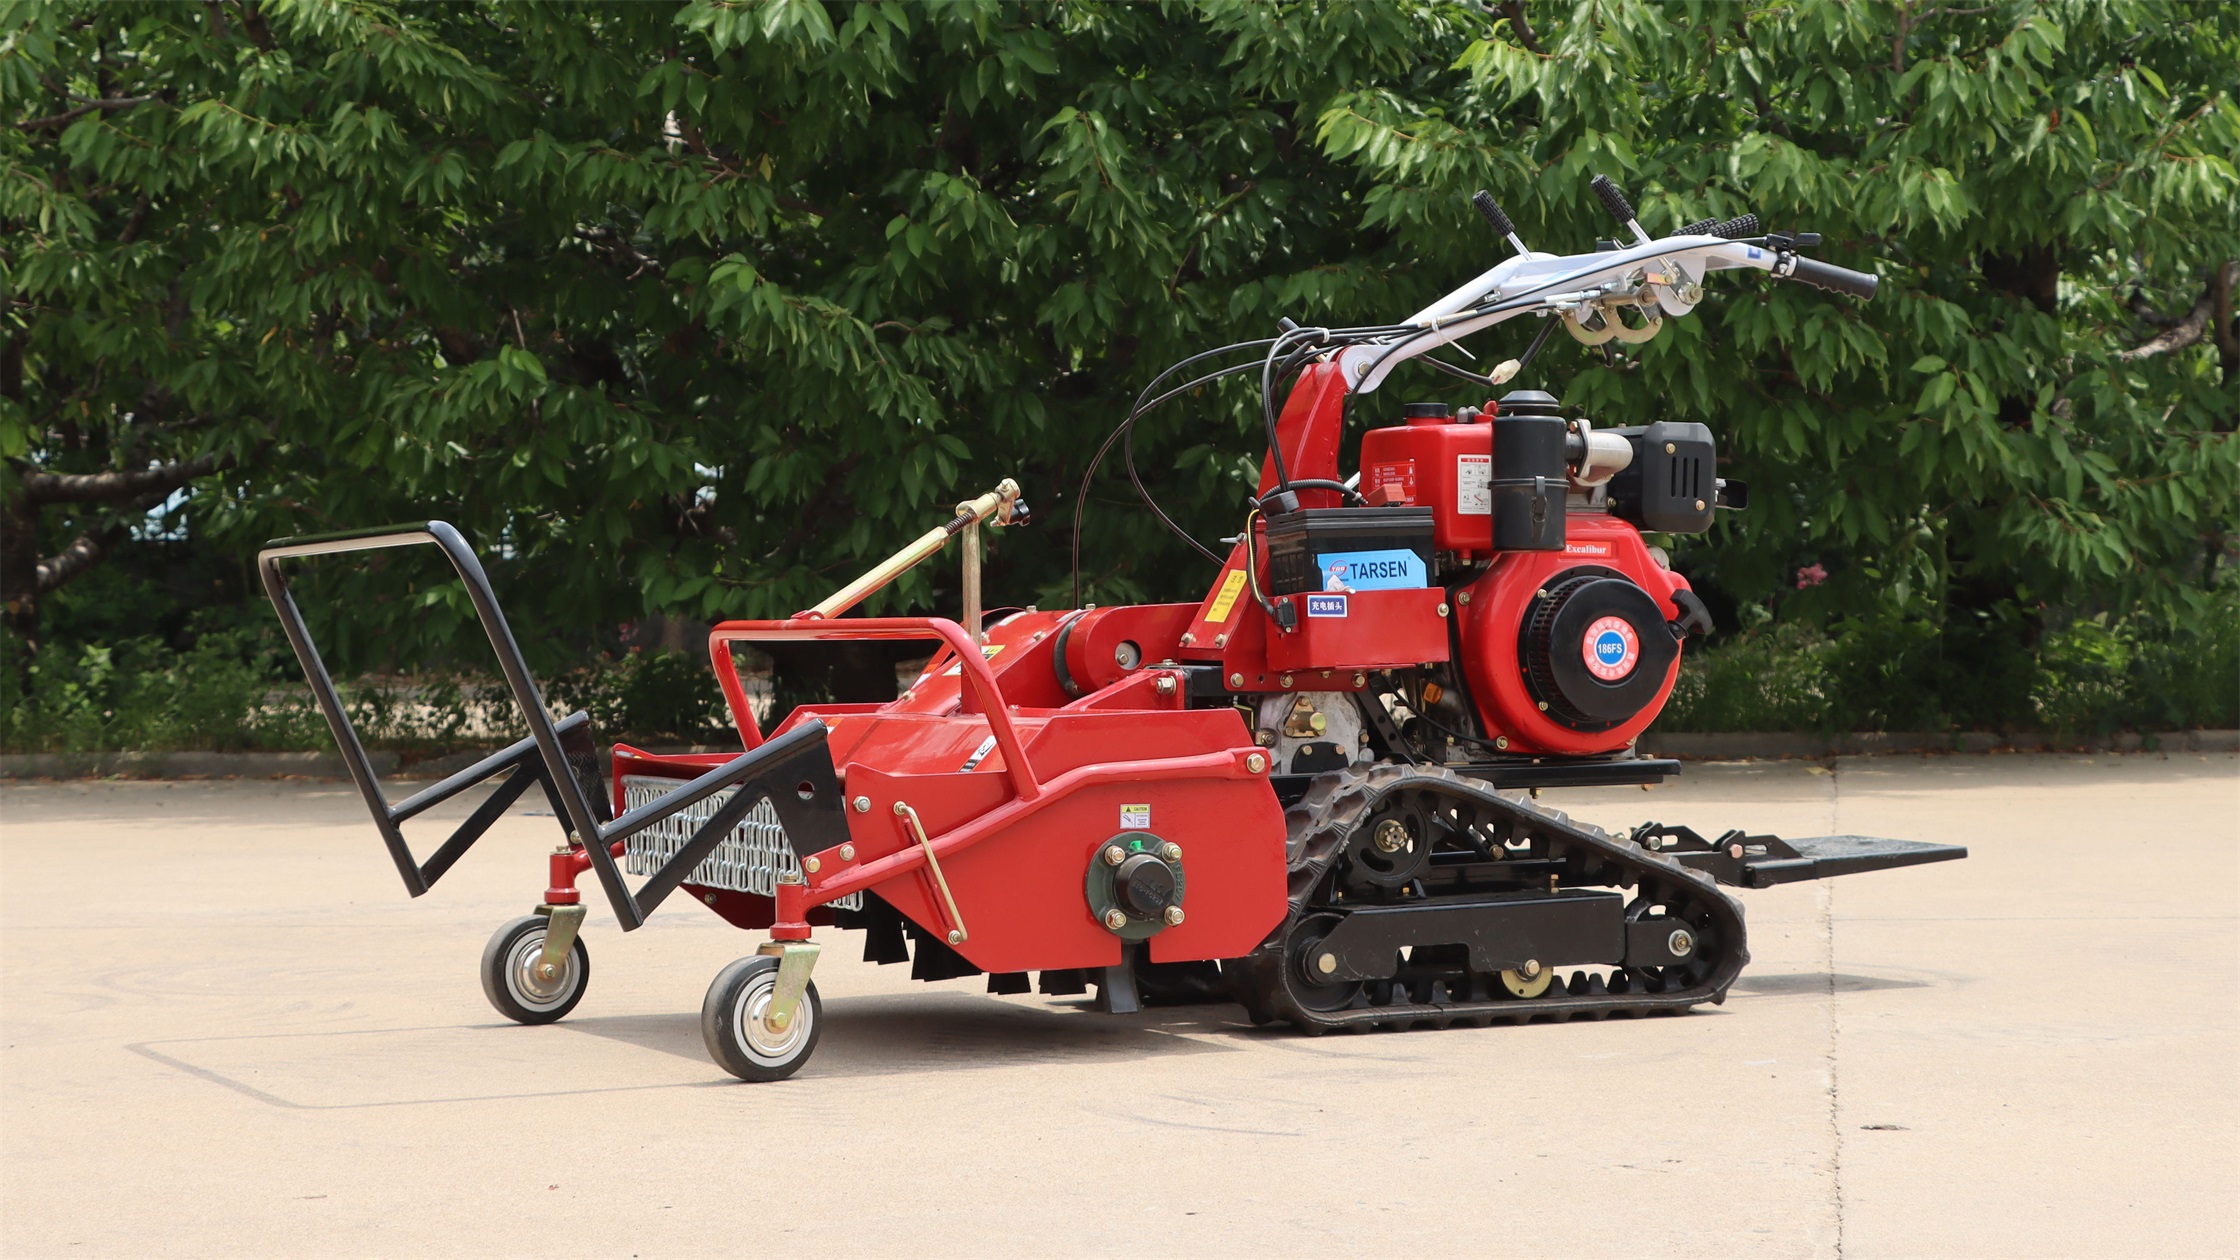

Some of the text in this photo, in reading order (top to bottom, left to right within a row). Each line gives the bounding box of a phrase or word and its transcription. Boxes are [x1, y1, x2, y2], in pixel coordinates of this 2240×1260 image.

[1566, 544, 1606, 554] Excalibur
[1350, 561, 1407, 579] TARSEN
[1312, 602, 1342, 610] 充电插头
[1597, 643, 1622, 653] 186FS
